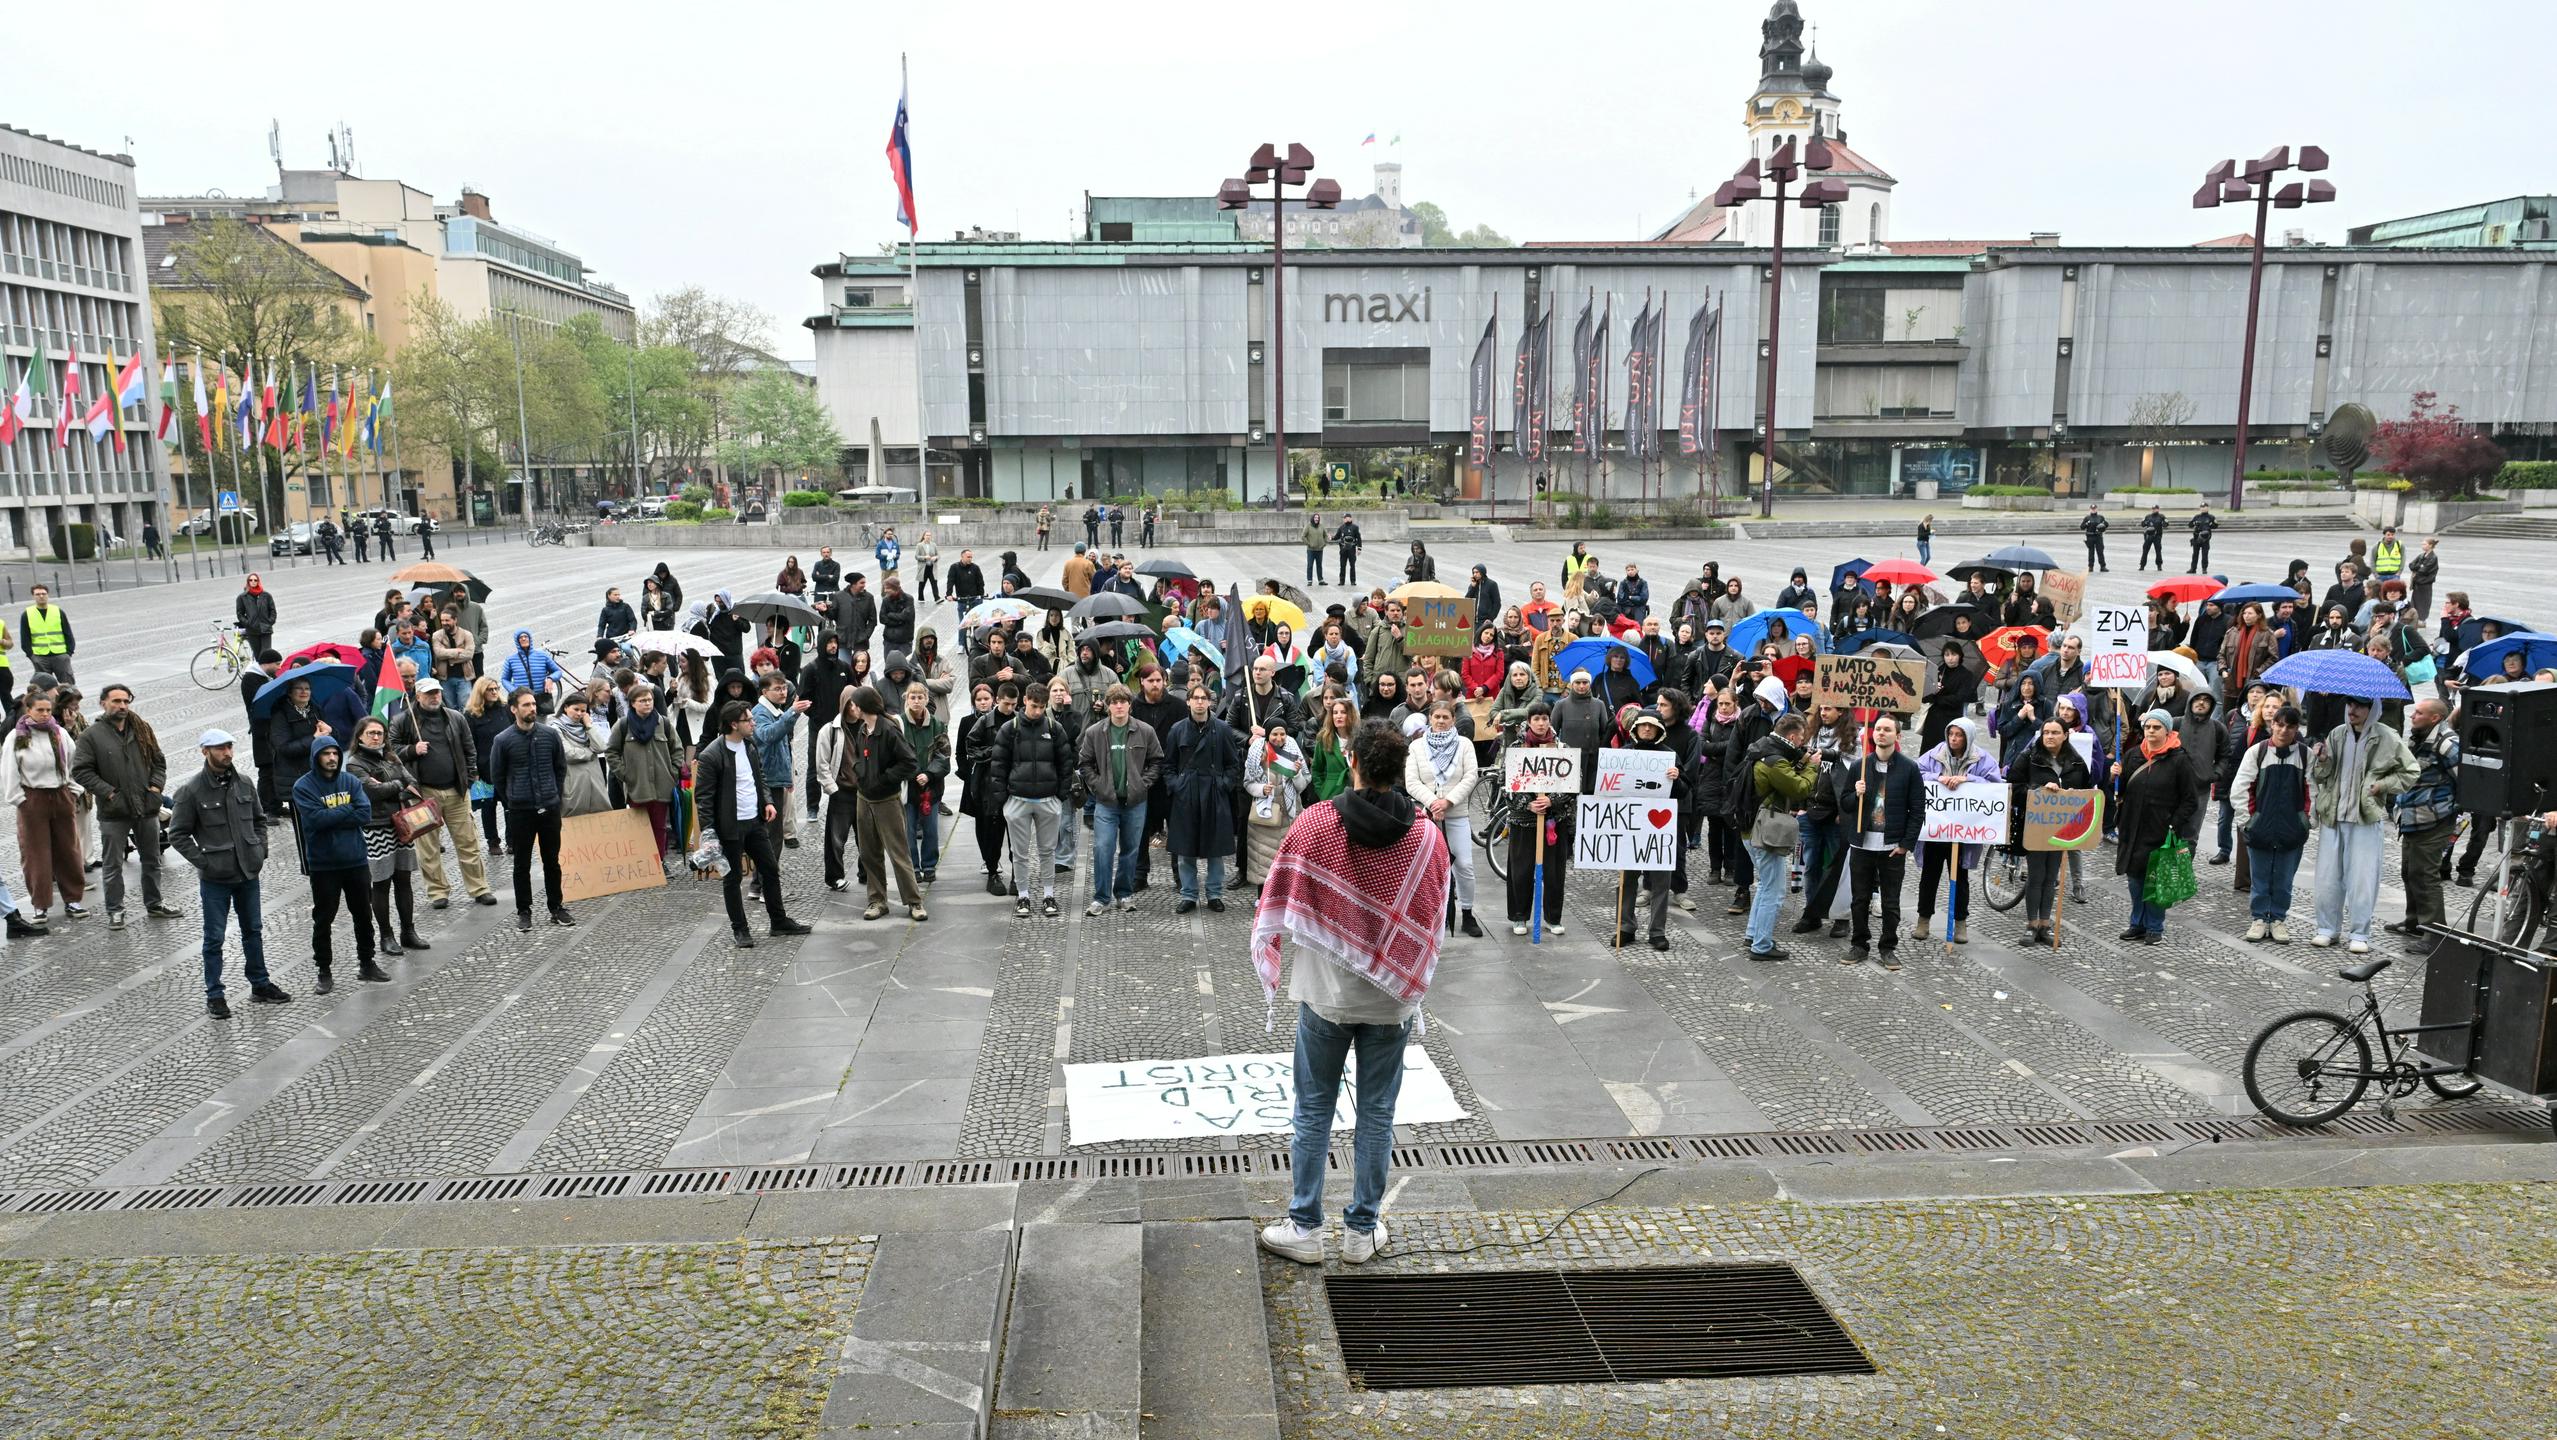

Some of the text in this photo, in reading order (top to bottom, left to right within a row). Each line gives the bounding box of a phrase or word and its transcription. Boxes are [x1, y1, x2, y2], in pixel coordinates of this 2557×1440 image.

[1325, 286, 1431, 322] maxi
[1425, 600, 1457, 617] MIR
[2097, 609, 2146, 632] ZDA
[1406, 631, 1469, 649] BLAGINJA
[1835, 658, 1877, 674] NATO
[2091, 653, 2148, 681] AGRESOR
[1833, 681, 1876, 695] NAROD
[1850, 673, 1892, 686] VLADA
[1849, 695, 1899, 709] STRADA
[1521, 756, 1573, 778] NATO
[1599, 751, 1673, 772] ČLOVEČNOST
[1600, 773, 1625, 792] NE
[2034, 790, 2087, 807] SVOBODA
[1582, 803, 1642, 831] MAKE
[1928, 823, 1997, 840] UMIRAMO
[1580, 833, 1673, 865] NOT WAR
[562, 872, 585, 889] ZA
